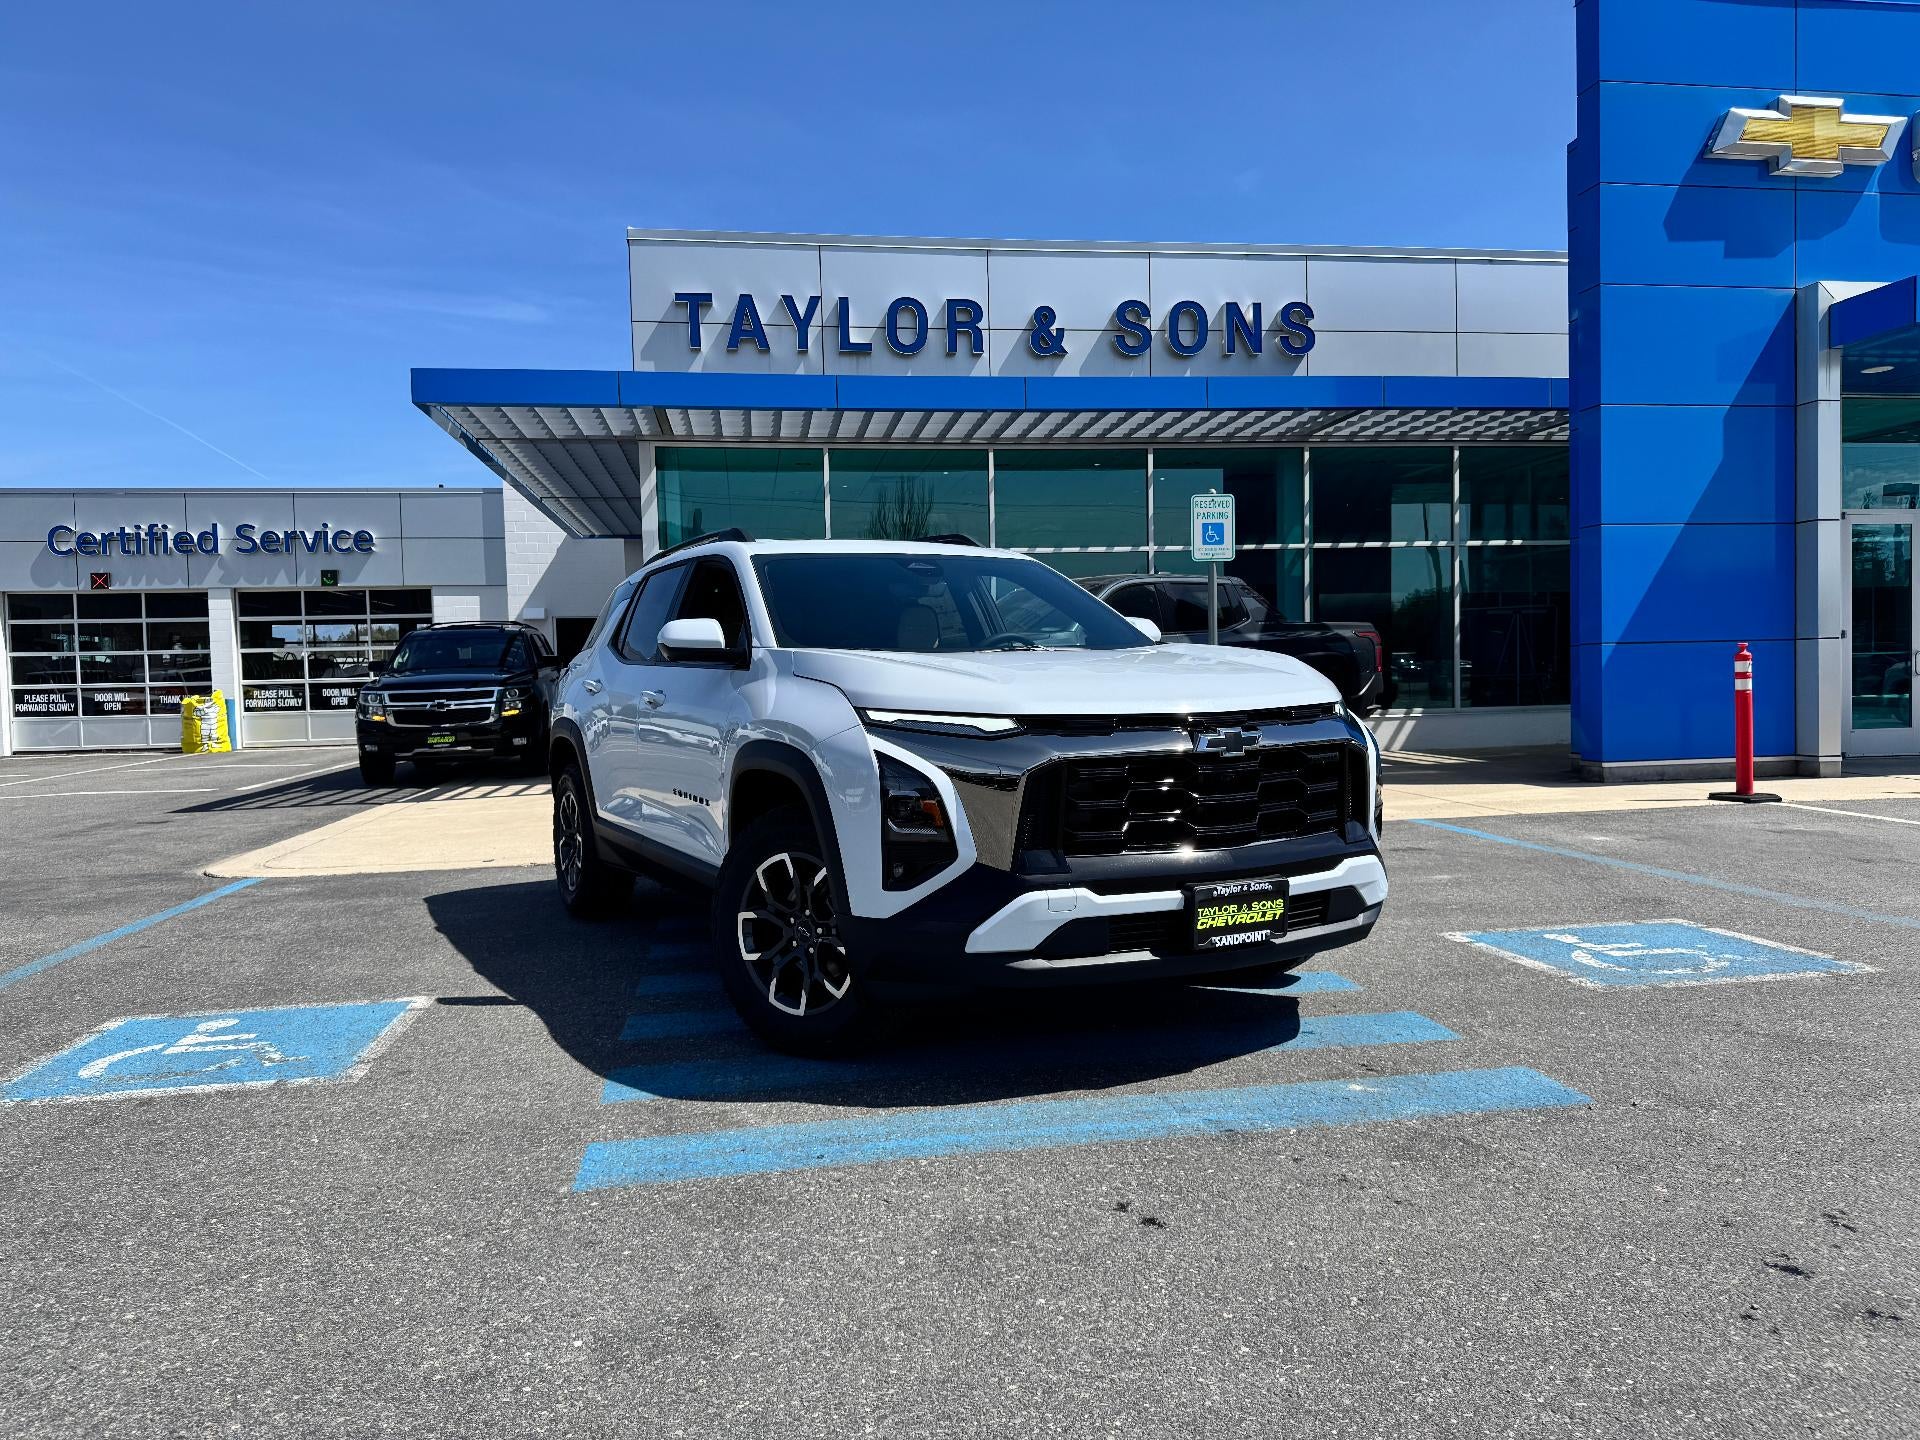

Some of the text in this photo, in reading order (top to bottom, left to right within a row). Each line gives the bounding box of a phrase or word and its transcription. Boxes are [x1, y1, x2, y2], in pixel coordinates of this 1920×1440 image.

[674, 292, 1316, 357] TAYLOR & SONS
[1195, 500, 1230, 509] RESERVED
[1197, 512, 1229, 520] PARKING
[47, 522, 375, 556] Certified Service
[94, 692, 130, 702] DOOR WILL
[253, 689, 294, 699] PLEASE PULL
[322, 688, 357, 697] DOOR WILL
[24, 694, 66, 703] PLEASE PULL
[160, 695, 181, 704] THANK
[245, 698, 302, 708] FORWARD SLOWLY
[331, 697, 348, 706] OPEN
[15, 703, 75, 712] FORWARD SLOWLY
[103, 702, 122, 711] OPEN
[1216, 884, 1241, 896] Taylor
[1198, 899, 1284, 918] TAYLOR & SONS
[1197, 910, 1284, 930] CHEVROLET
[1214, 930, 1267, 947] SANDPOINT
